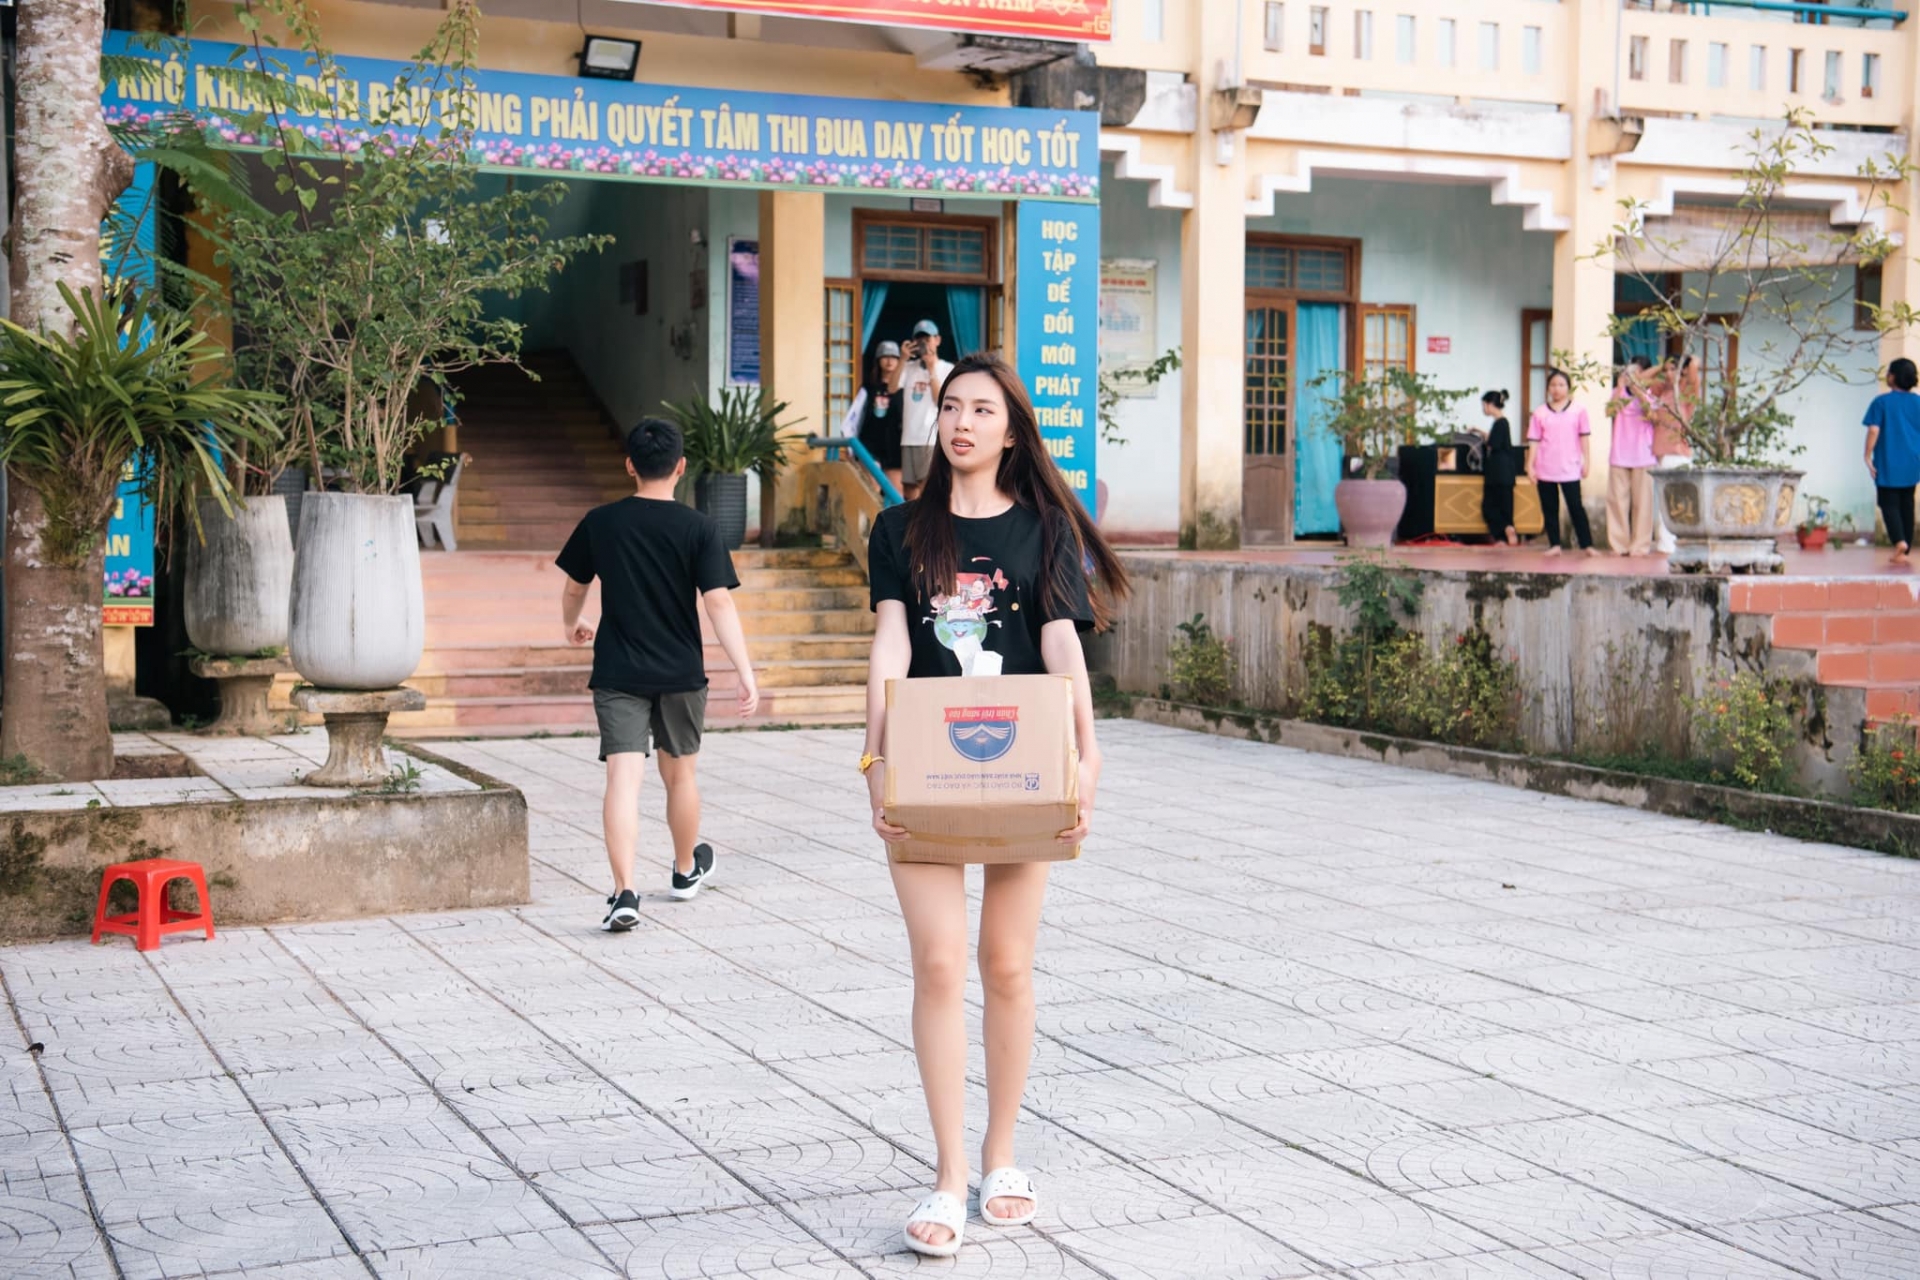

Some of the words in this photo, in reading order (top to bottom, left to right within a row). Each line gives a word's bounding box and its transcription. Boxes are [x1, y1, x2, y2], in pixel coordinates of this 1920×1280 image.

[531, 87, 598, 140] PHẢI
[607, 95, 693, 147] QUYẾT
[701, 102, 759, 151] TÂM
[767, 114, 808, 154] THI
[815, 117, 867, 157] ĐUA
[874, 120, 923, 168] DẠY
[931, 112, 975, 162] TỐT
[982, 127, 1031, 172] HỌC
[1037, 118, 1080, 168] TỐT
[1042, 220, 1078, 244] HỌC
[1042, 248, 1076, 275] TẬP
[1041, 342, 1076, 365] MỚI
[1035, 372, 1082, 397] PHÁT
